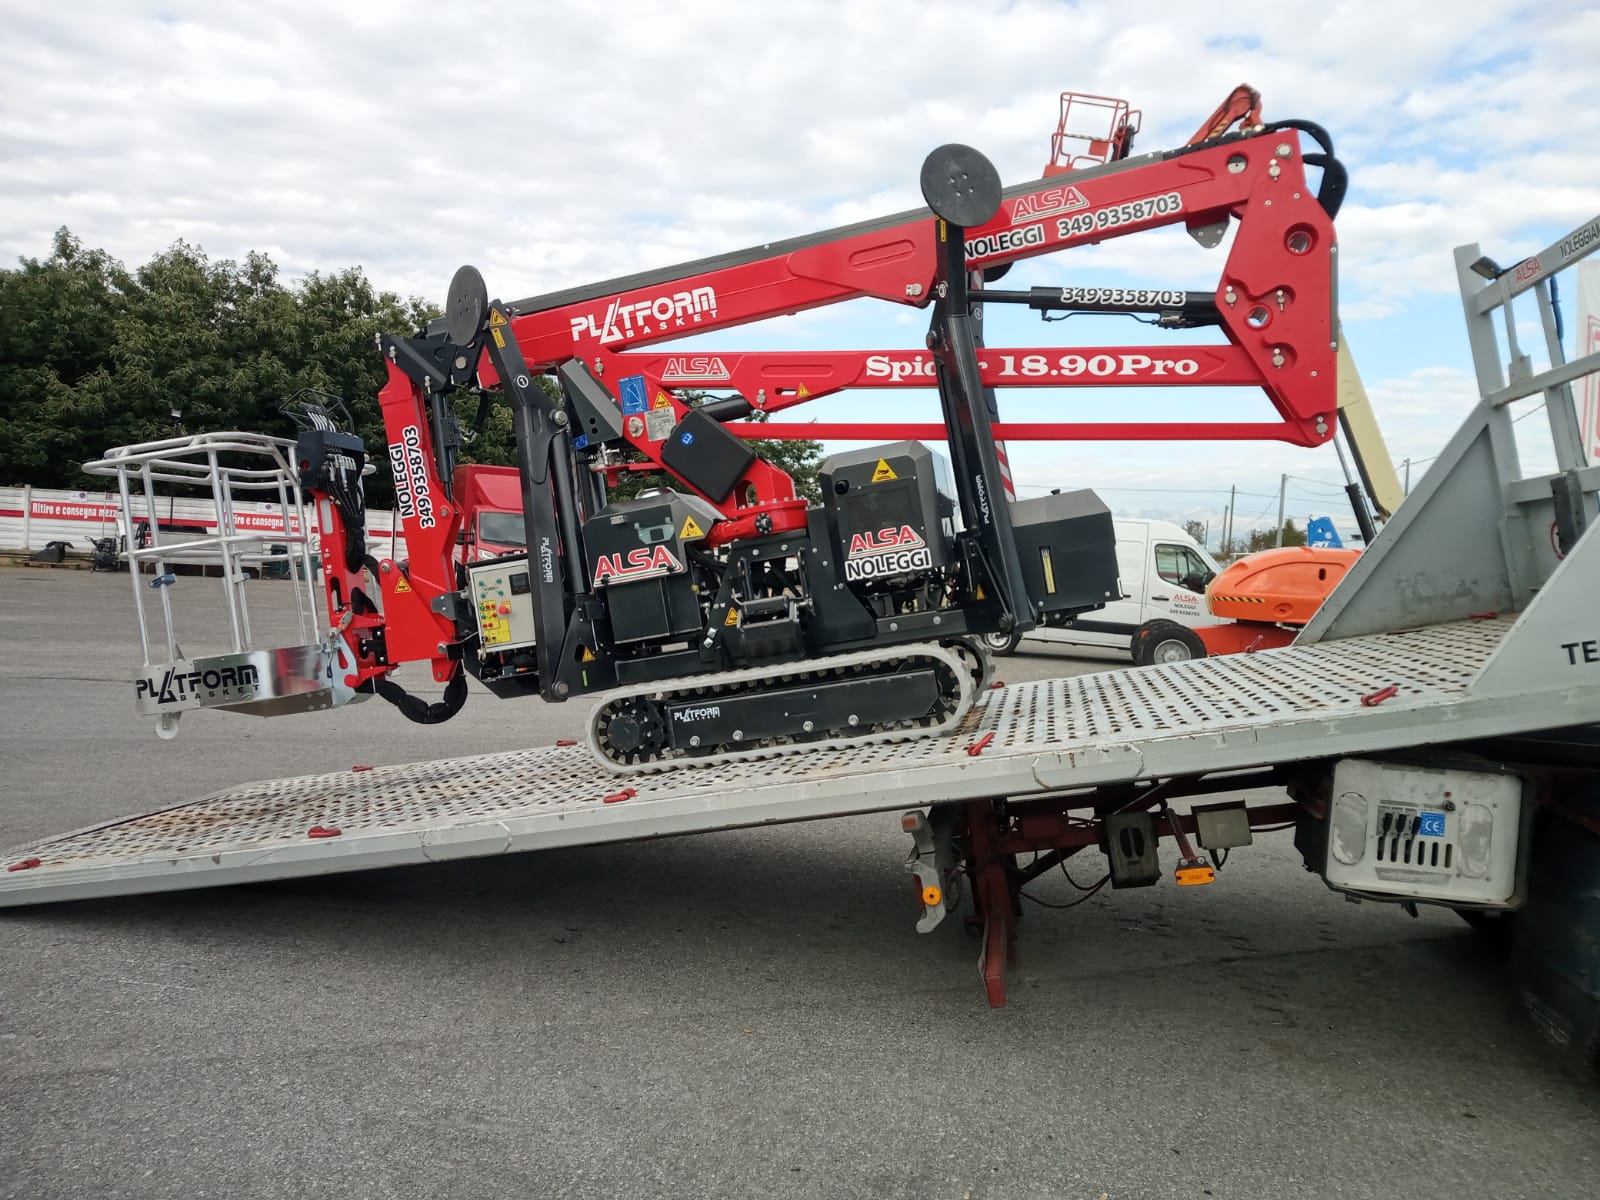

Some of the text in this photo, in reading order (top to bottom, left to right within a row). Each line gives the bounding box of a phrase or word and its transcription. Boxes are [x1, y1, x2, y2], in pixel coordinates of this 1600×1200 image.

[1013, 186, 1083, 220] ALSA
[964, 225, 1044, 261] NOLEGGI
[1515, 256, 1542, 284] ALSA
[570, 286, 717, 344] PLATFORM
[625, 309, 718, 338] BASKET
[663, 357, 726, 377] ALSA
[865, 355, 988, 382] Spir
[389, 443, 414, 517] NOLEGGI
[32, 502, 54, 514] Ritiro
[55, 506, 60, 515] e
[62, 505, 97, 519] consegna
[245, 516, 250, 526] e
[251, 516, 284, 529] consegna
[848, 525, 919, 554] ALSA
[540, 536, 554, 583] PLATFORM
[594, 545, 676, 582] ALSA
[845, 549, 931, 580] NOLEGGI
[1173, 594, 1198, 603] ALSA
[135, 667, 259, 704] PLATFORM
[180, 683, 260, 701] BASKET
[673, 706, 720, 722] PLATFORM
[1424, 819, 1440, 832] CE
